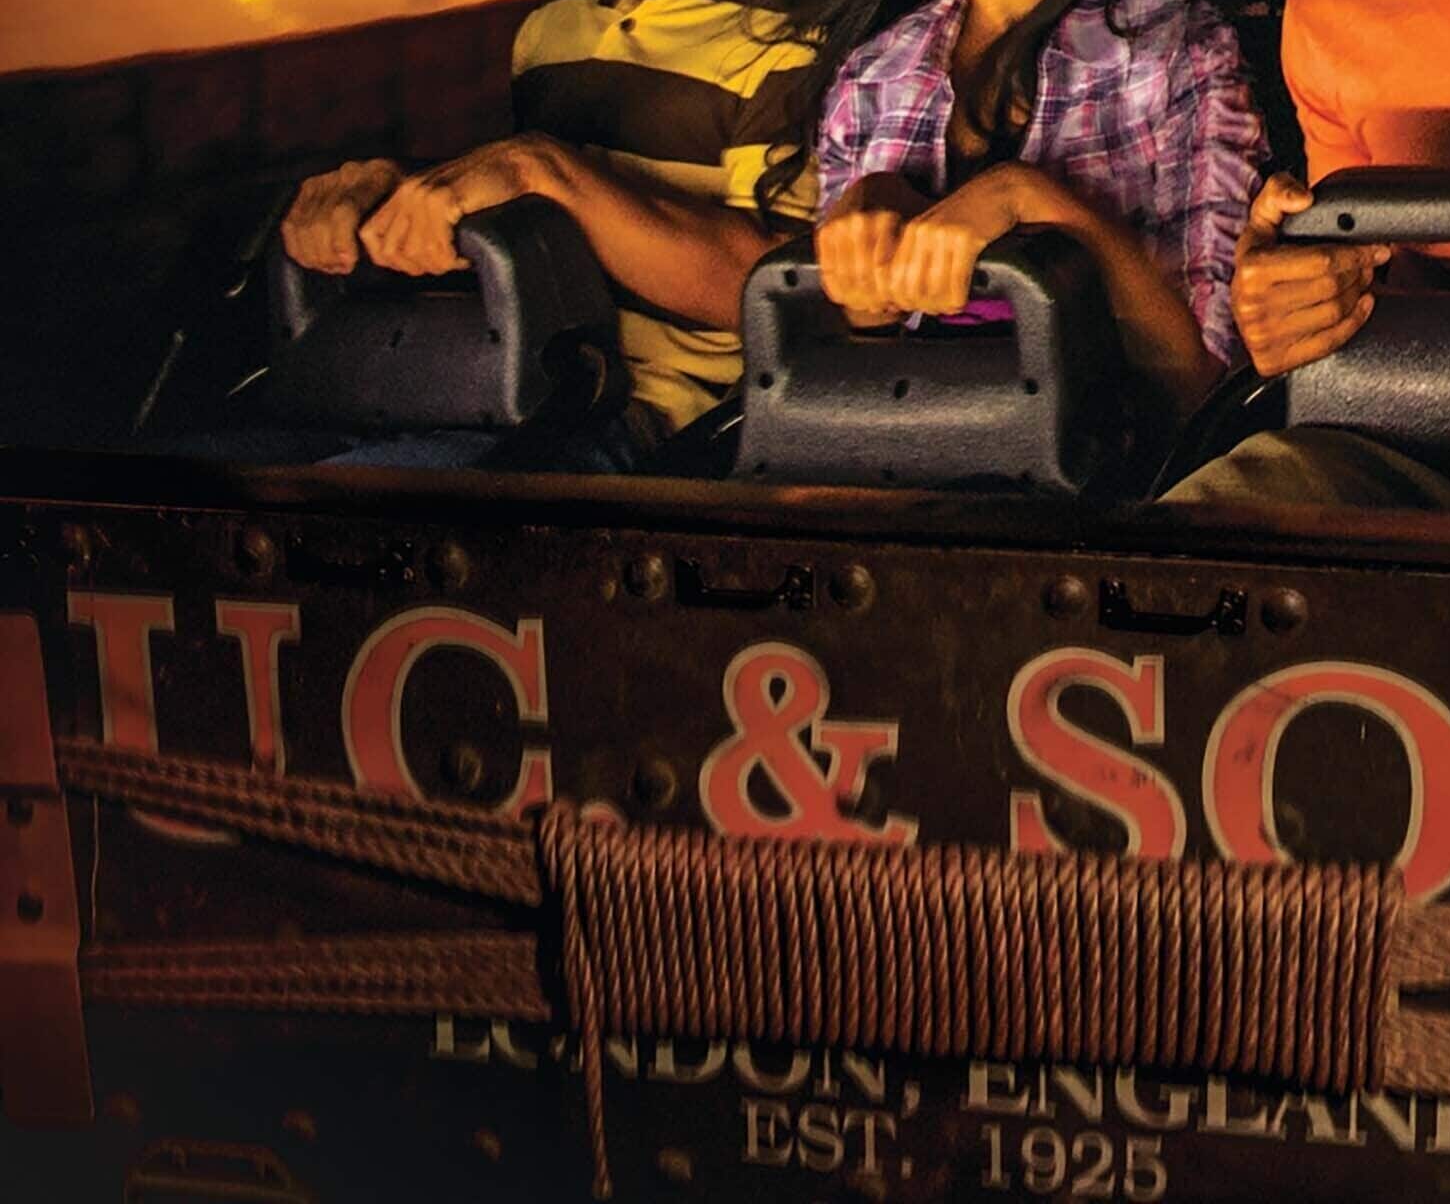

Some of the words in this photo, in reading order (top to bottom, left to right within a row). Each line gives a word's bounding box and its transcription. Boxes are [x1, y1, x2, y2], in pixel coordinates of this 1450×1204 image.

[700, 641, 919, 844] &
[739, 1095, 916, 1176] EST.
[979, 1122, 1169, 1200] 1925
